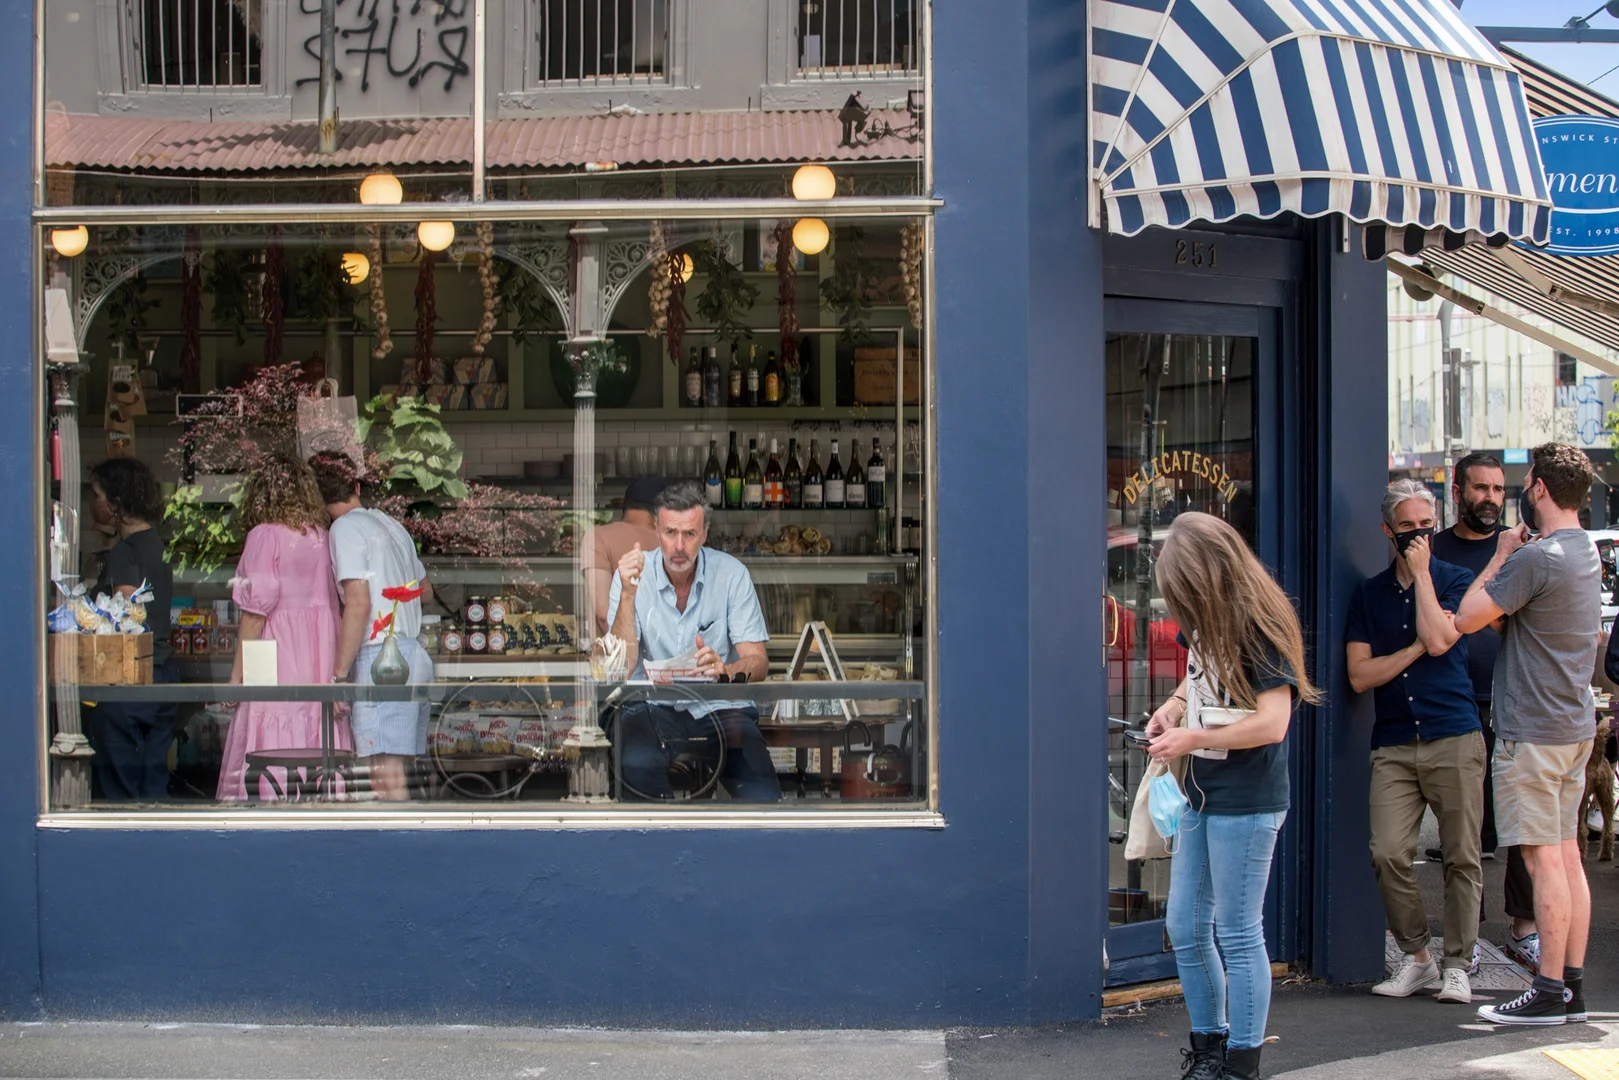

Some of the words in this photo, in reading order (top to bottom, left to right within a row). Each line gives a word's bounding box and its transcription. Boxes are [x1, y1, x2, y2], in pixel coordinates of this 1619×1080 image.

[1541, 134, 1594, 144] NSWICK
[1604, 136, 1618, 145] ST
[1543, 166, 1618, 194] men
[1587, 227, 1619, 237] 1998
[1175, 239, 1218, 268] 251
[1123, 450, 1238, 504] DELICATESSEN
